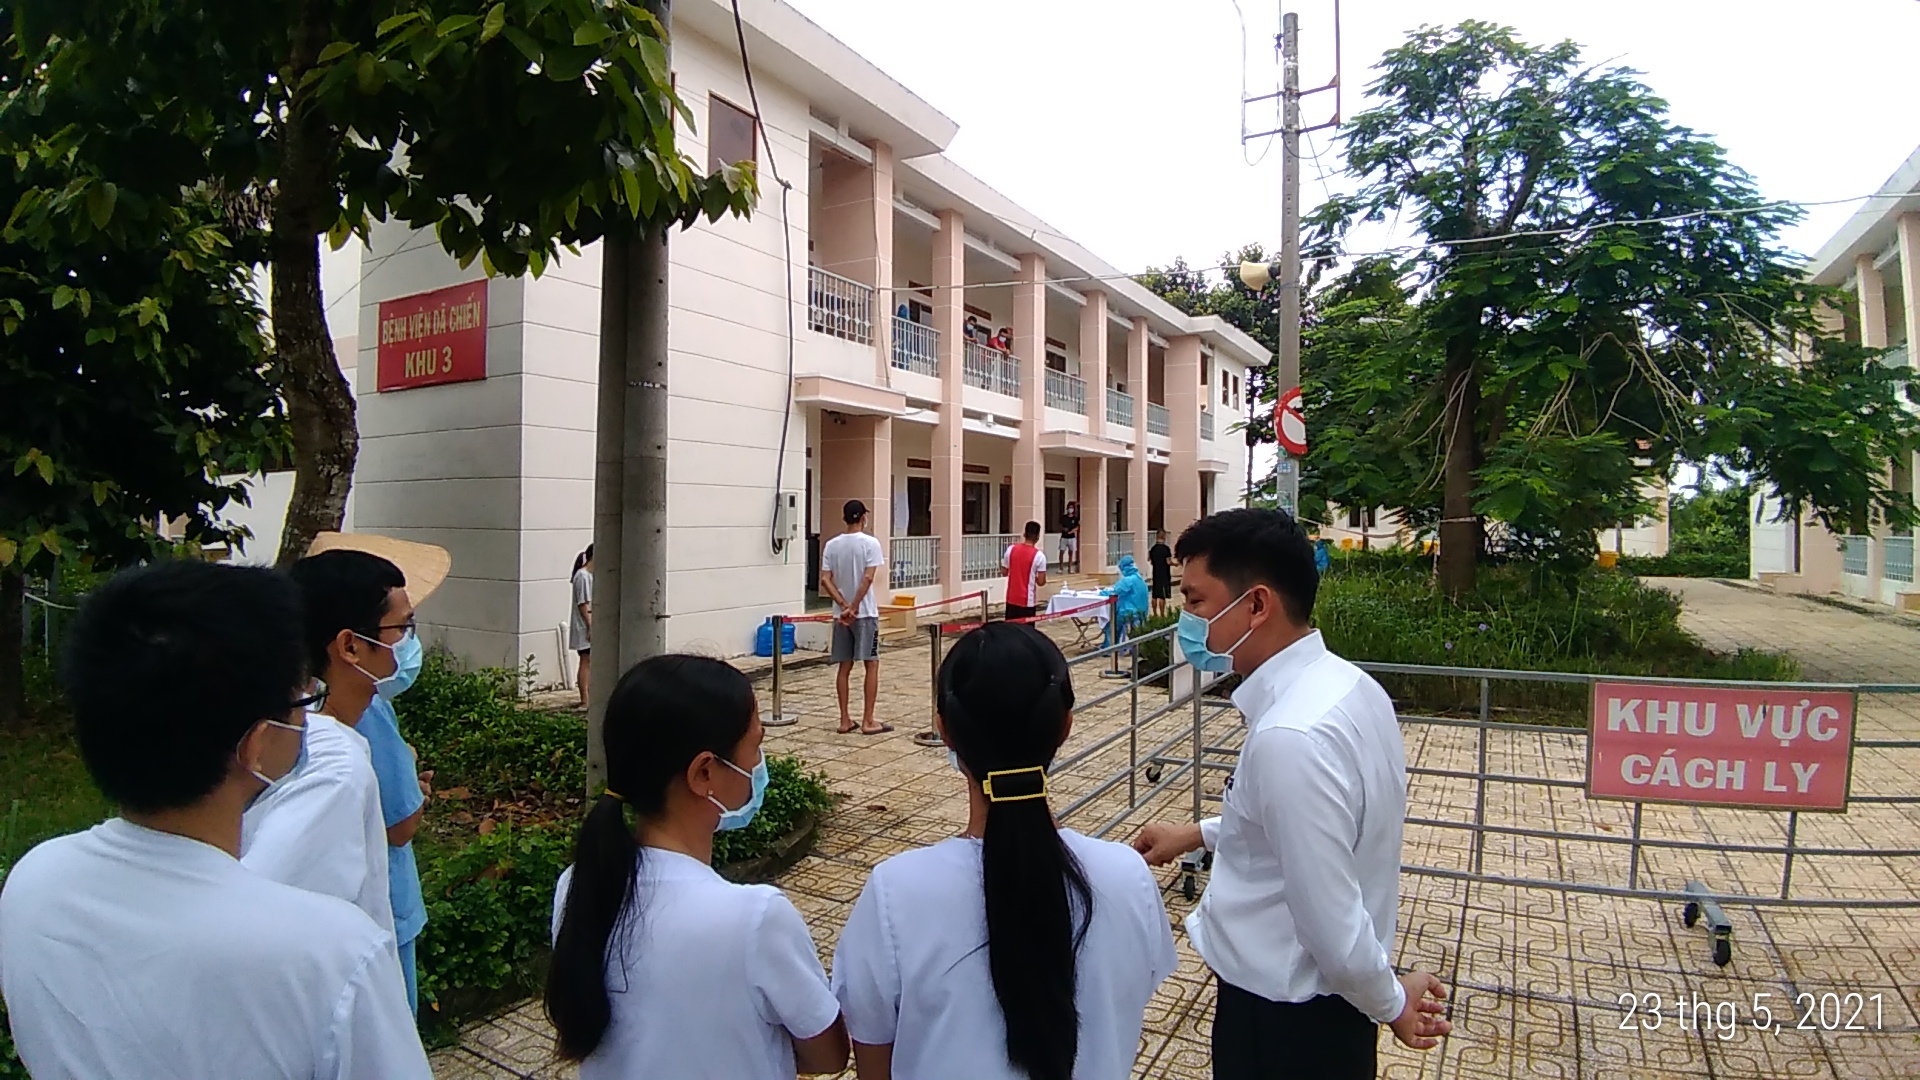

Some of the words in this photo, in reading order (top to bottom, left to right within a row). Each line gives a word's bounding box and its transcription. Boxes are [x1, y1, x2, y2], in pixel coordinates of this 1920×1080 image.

[382, 312, 406, 348] BỆNH
[409, 306, 431, 343] VIỆN
[449, 292, 480, 332] CHIẾN
[405, 349, 436, 378] KHU
[442, 346, 452, 373] 3
[1607, 698, 1716, 737] KHU
[1736, 698, 1839, 747] VỰC
[1620, 749, 1745, 790] CÁCH
[1764, 761, 1819, 793] LY
